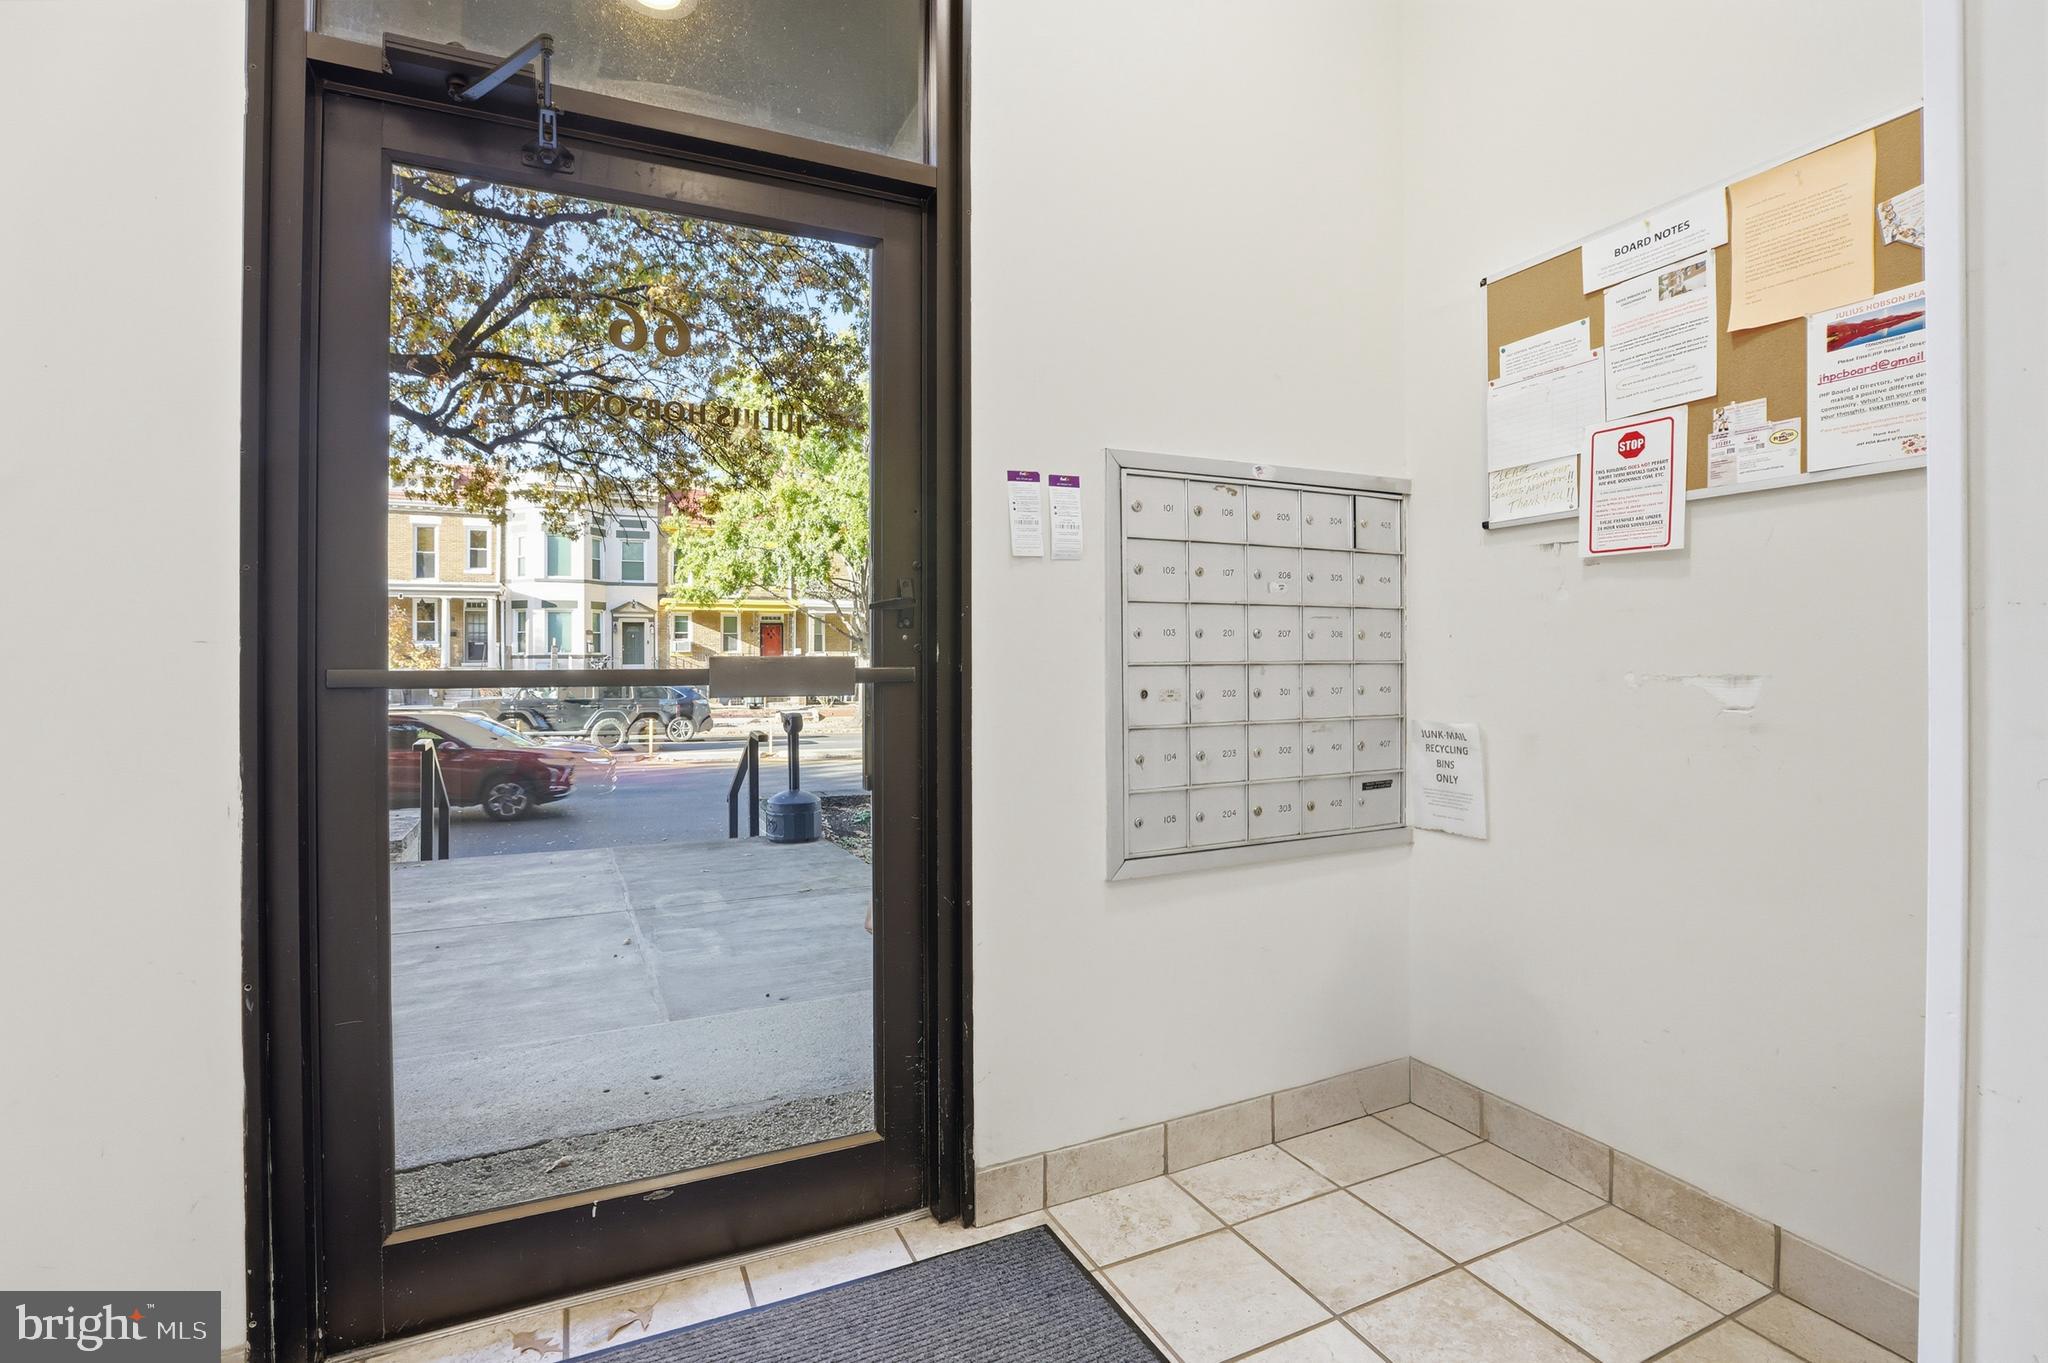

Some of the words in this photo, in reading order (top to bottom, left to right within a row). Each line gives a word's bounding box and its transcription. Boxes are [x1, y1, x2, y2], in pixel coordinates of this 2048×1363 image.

[1614, 236, 1651, 257] BOARD
[1654, 220, 1690, 242] NOTES
[1835, 307, 1864, 319] JULIUS
[1866, 295, 1906, 311] HOBSON
[1831, 387, 1850, 396] Board
[1860, 388, 1887, 399] positive
[1619, 438, 1644, 452] STOP
[1163, 504, 1174, 512] 101
[1163, 566, 1176, 575] 102
[1223, 569, 1235, 577] 107
[1278, 572, 1292, 580] 206
[1163, 628, 1176, 637] 103
[1223, 629, 1235, 637] 201
[1278, 630, 1291, 638] 207
[1222, 689, 1236, 698] 202
[1280, 688, 1291, 696] 301
[1331, 687, 1344, 695] 307
[1421, 729, 1468, 742] JUNK-MAIL
[1331, 743, 1343, 751] 401
[1379, 740, 1391, 748] 407
[1222, 749, 1237, 758] 203
[1278, 746, 1292, 754] 302
[1425, 743, 1469, 756] RECYCLING
[1164, 753, 1177, 762] 104
[1436, 759, 1455, 770] BINS
[1436, 773, 1459, 785] ONLY
[1278, 804, 1292, 813] 303
[1330, 800, 1343, 808] 402
[1222, 810, 1237, 819] 204
